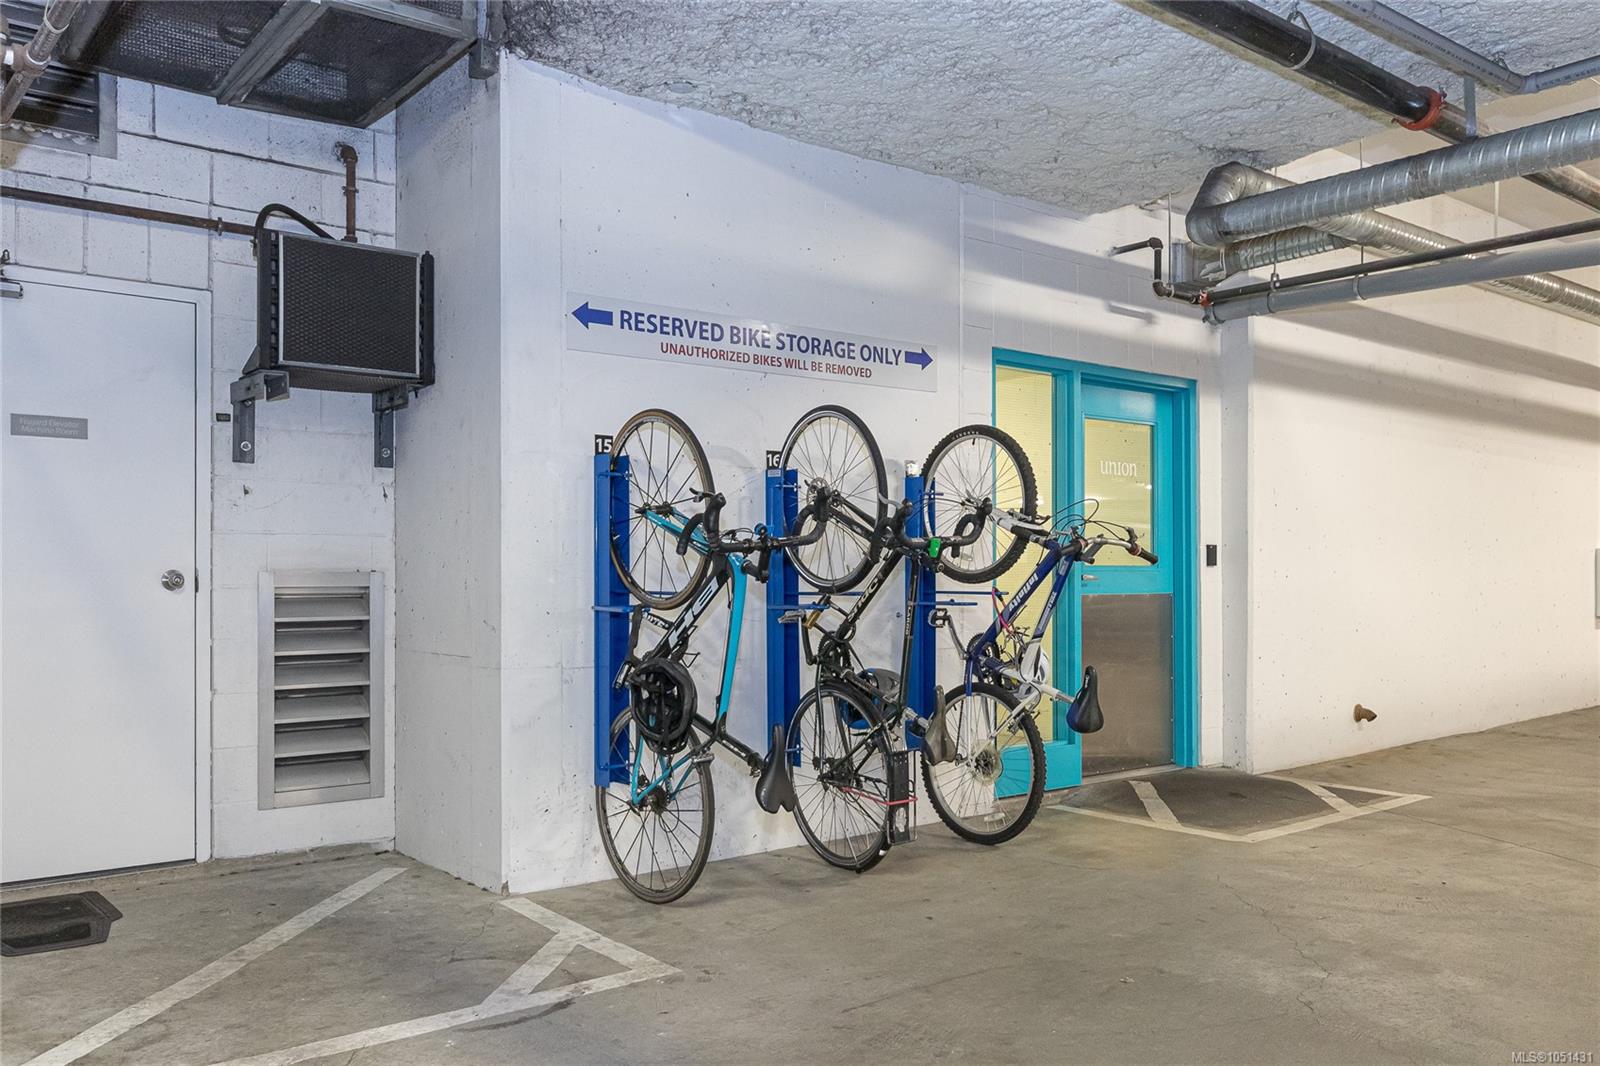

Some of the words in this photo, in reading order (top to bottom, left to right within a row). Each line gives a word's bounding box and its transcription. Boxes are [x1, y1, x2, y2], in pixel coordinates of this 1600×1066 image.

[619, 310, 724, 342] RESERVED
[729, 325, 771, 349] BIKE
[775, 332, 856, 360] STORAGE
[860, 344, 902, 367] ONLY
[660, 342, 751, 364] UNAUTHORIZED
[753, 352, 783, 369] BIKES
[784, 356, 809, 371] WILL
[811, 361, 823, 373] BE
[825, 362, 873, 379] REMOVED
[596, 438, 613, 453] 15
[767, 453, 781, 468] 16
